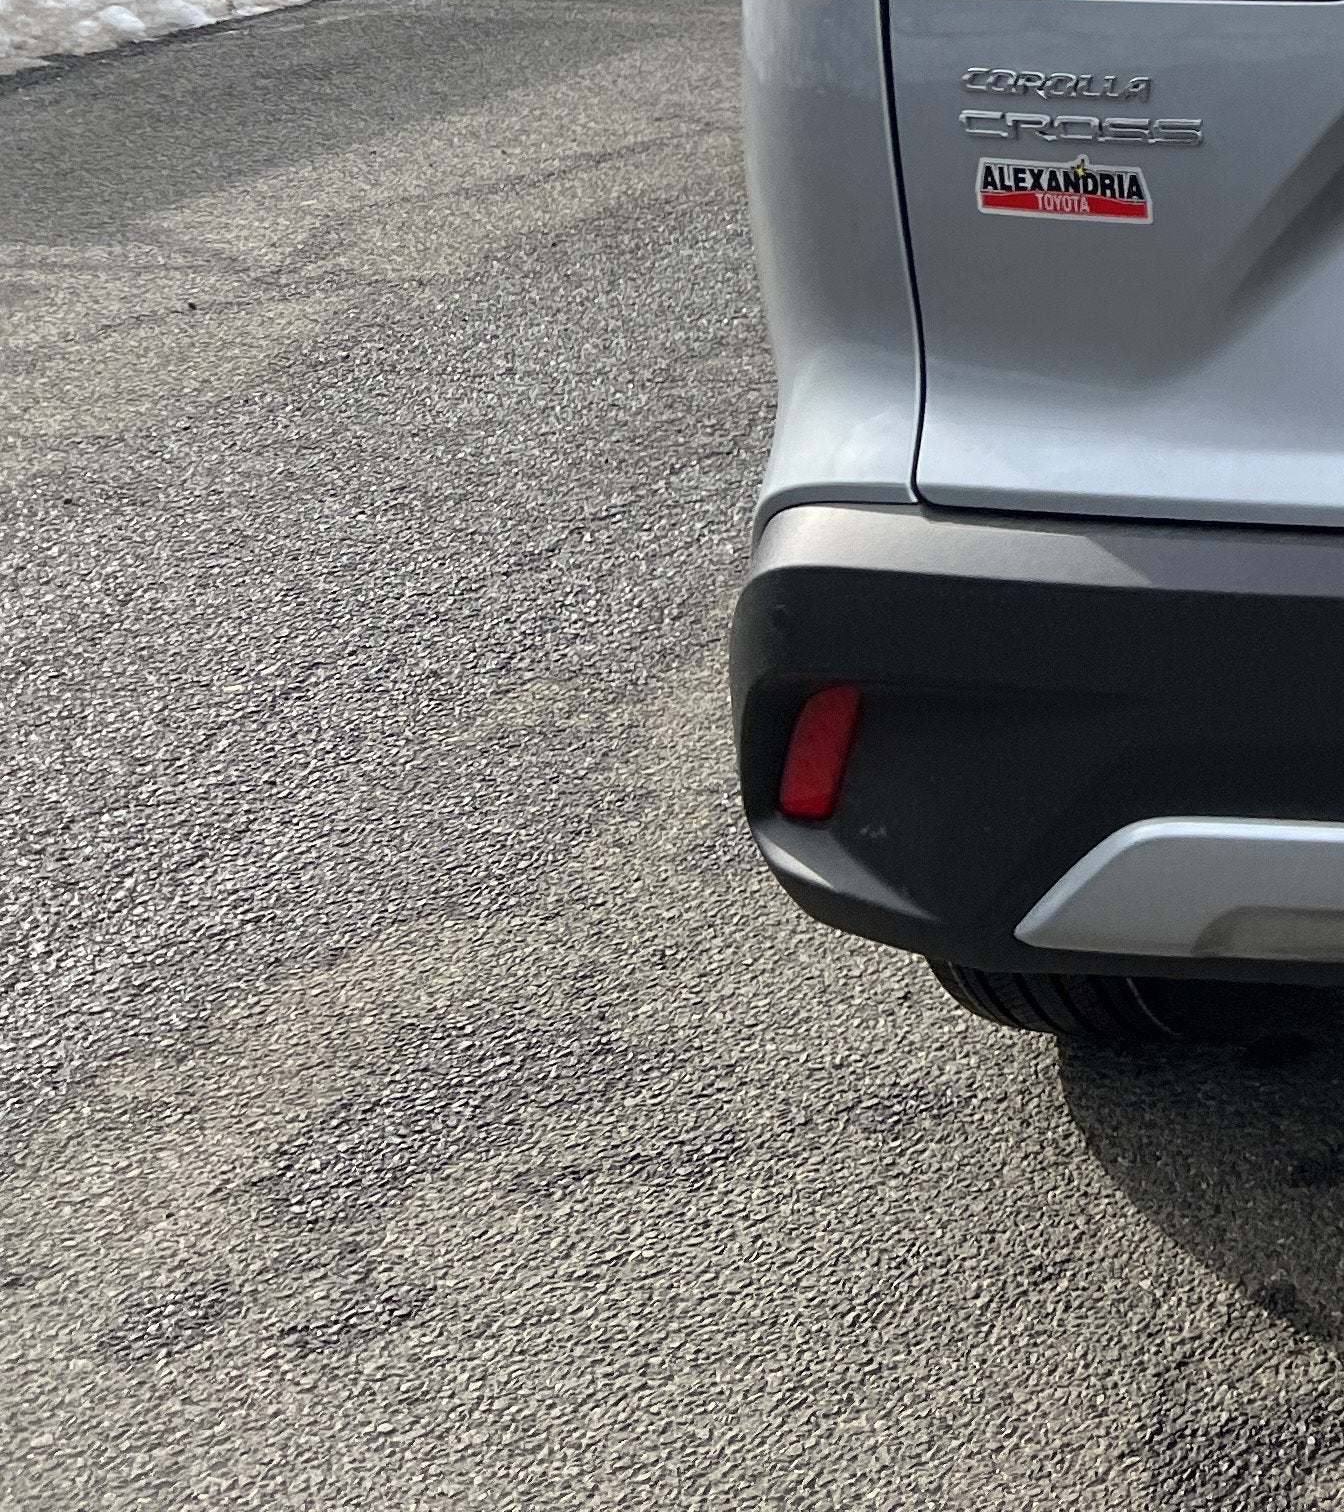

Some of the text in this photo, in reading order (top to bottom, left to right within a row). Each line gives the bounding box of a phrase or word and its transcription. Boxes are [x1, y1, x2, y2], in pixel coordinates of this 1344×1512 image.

[961, 67, 1152, 100] COROLLA
[959, 109, 1203, 145] CROSS
[982, 165, 1144, 200] ALEXANDRIA
[1035, 193, 1091, 214] TOYOTA
